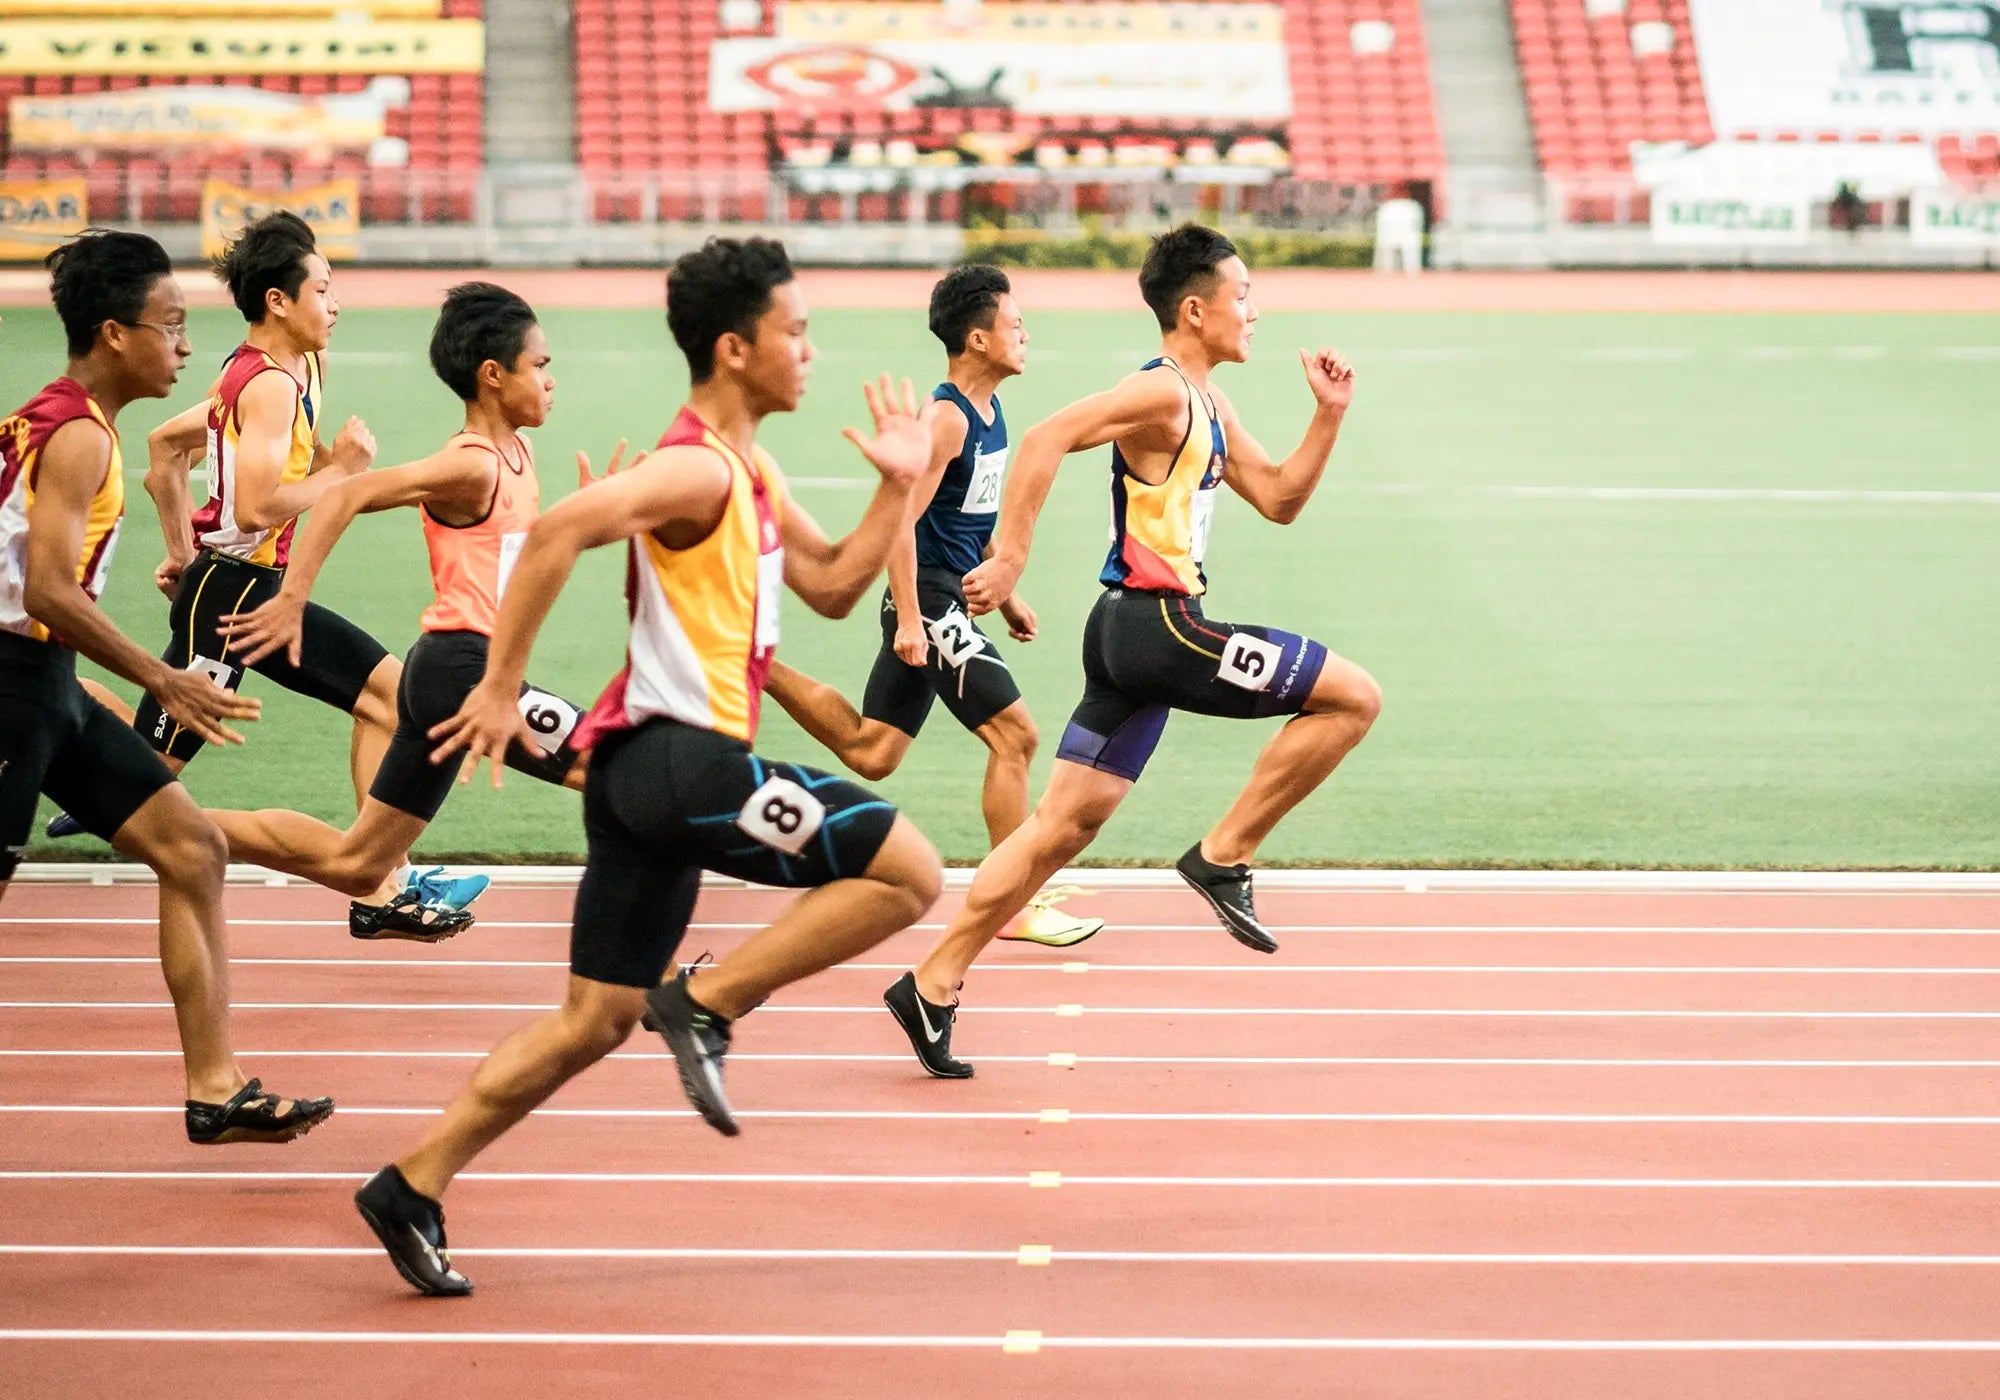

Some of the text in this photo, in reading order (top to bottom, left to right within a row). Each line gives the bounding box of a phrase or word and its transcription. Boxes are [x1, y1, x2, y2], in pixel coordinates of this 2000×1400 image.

[976, 472, 998, 504] 28
[942, 624, 972, 655] 2
[1231, 646, 1265, 678] 5
[525, 704, 561, 734] 6
[763, 796, 802, 834] 8
